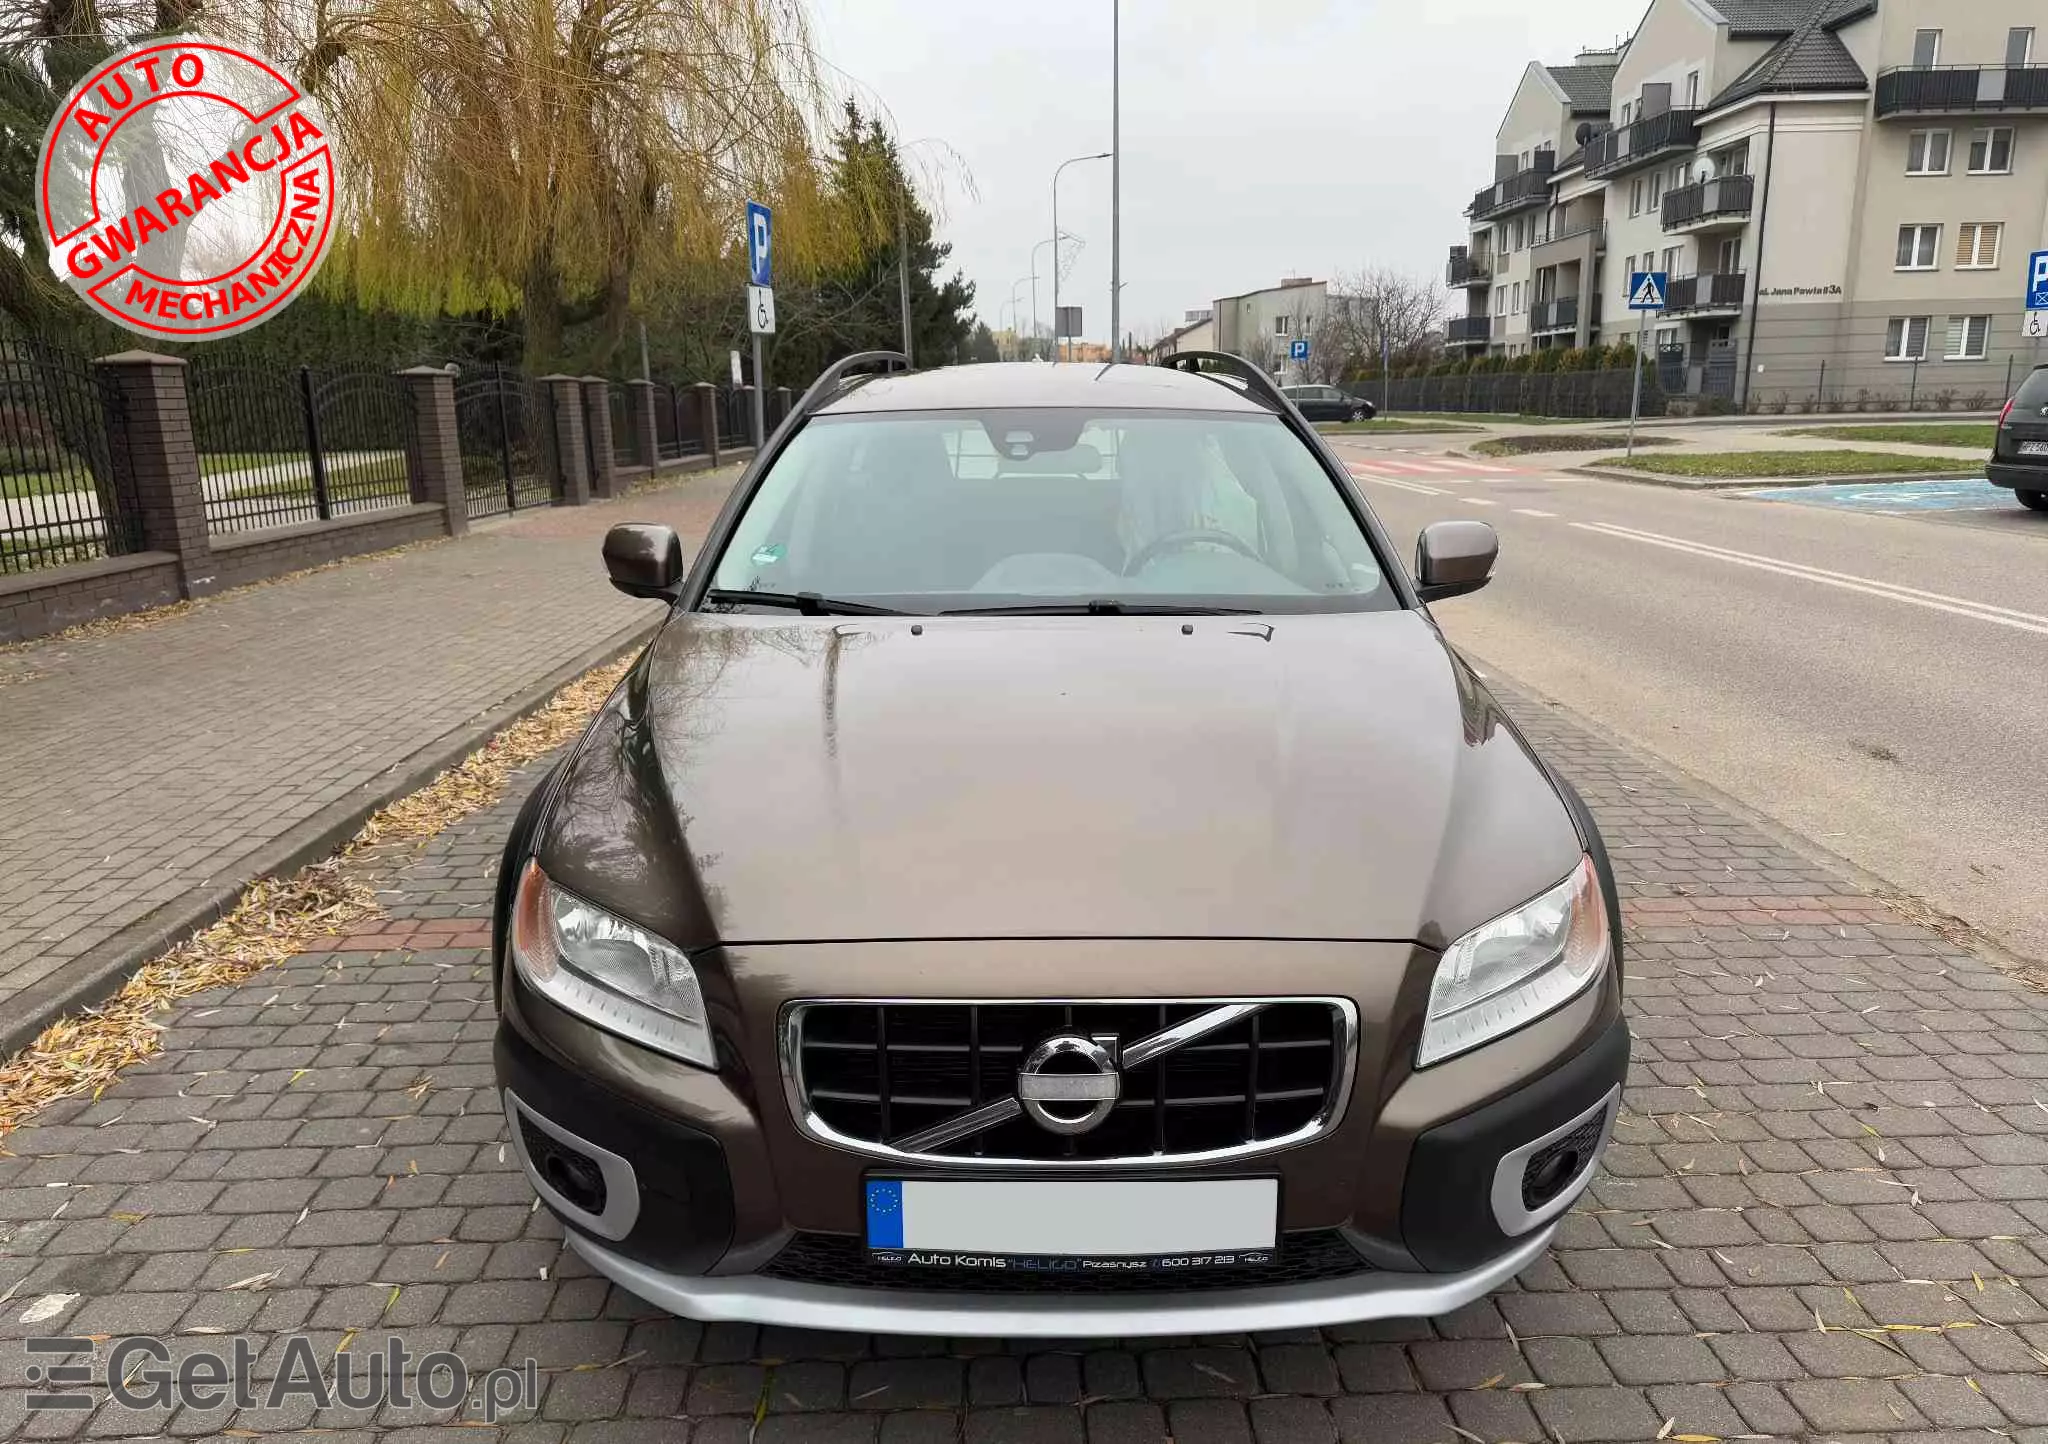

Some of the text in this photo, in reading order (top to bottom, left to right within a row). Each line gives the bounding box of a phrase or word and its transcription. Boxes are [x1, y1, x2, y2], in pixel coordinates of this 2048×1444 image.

[753, 212, 768, 274] P
[1771, 287, 1792, 296] Jana
[1294, 342, 1305, 357] P
[908, 1252, 951, 1265] Auto
[955, 1254, 1007, 1268] Komis
[1162, 1258, 1189, 1268] 600
[1192, 1256, 1212, 1266] 317
[1214, 1255, 1235, 1265] 213
